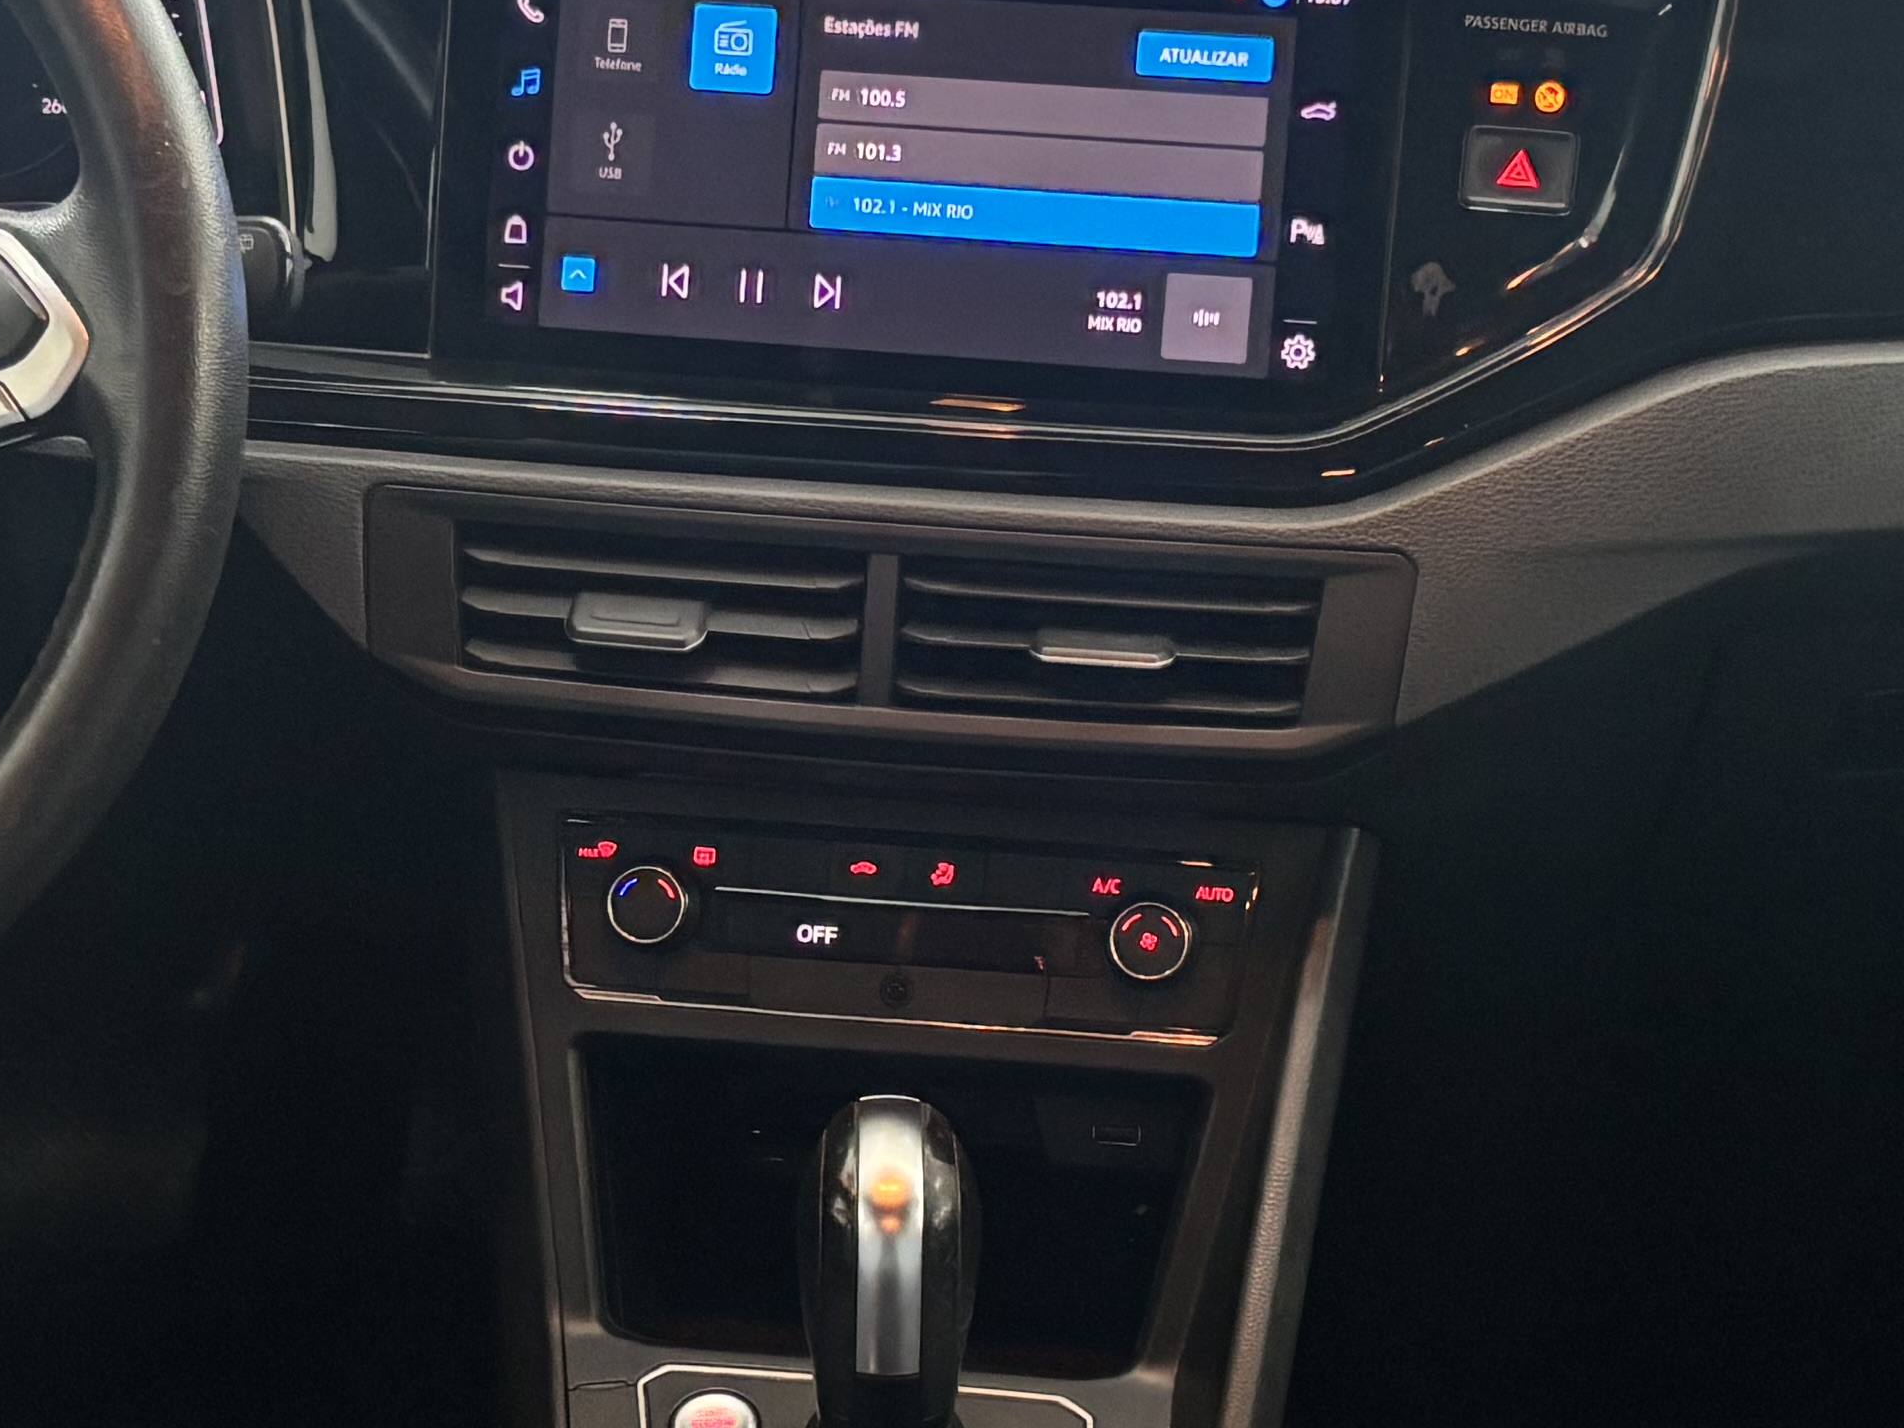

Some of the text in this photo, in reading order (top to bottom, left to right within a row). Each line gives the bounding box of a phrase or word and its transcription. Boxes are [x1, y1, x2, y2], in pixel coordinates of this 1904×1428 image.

[824, 15, 920, 39] Estações FM
[1464, 14, 1609, 39] PASSENGER AIRBAG
[595, 56, 642, 72] Telefone
[1159, 47, 1249, 67] ATUALIZAR
[831, 88, 906, 108] FM 100.5
[827, 142, 902, 162] FM 101.3
[599, 166, 622, 179] USB
[854, 197, 895, 214] 102.1
[913, 201, 942, 218] MIX
[947, 204, 974, 220] RIO
[1096, 291, 1142, 311] 102.1
[1088, 315, 1142, 334] MIX RIO
[1092, 877, 1122, 894] A/C
[1195, 886, 1235, 903] AUTO
[796, 924, 838, 944] OFF
